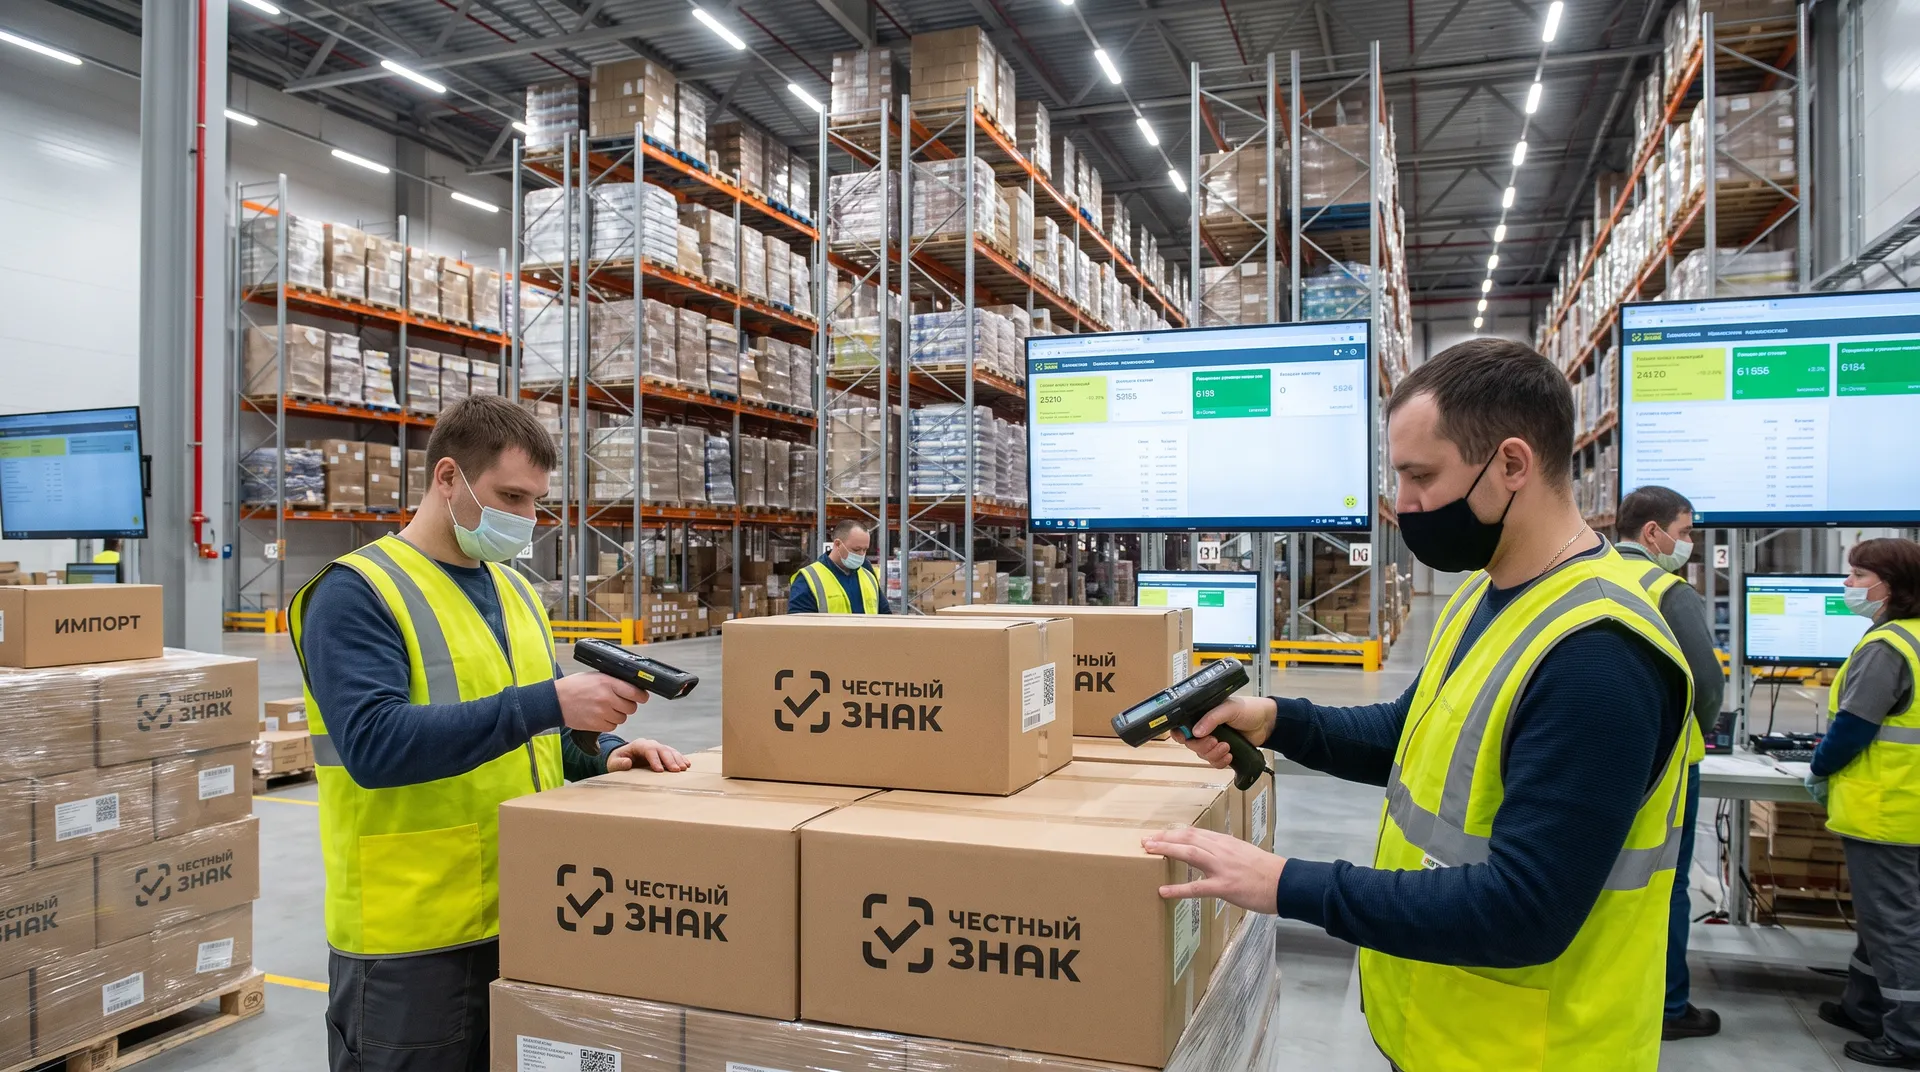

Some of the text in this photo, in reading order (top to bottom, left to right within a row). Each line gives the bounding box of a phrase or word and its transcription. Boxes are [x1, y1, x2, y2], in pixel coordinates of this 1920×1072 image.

[1040, 396, 1062, 404] 25210
[1716, 549, 1727, 565] 3
[55, 614, 141, 635] ИМПОРТ
[1072, 651, 1116, 667] НЫЙ
[178, 686, 233, 704] ЧЕСТНЫЙ
[842, 679, 944, 699] ЧЕСТНЫЙ
[178, 700, 233, 722] ЗНАК
[841, 701, 944, 733] ЗНАК
[176, 848, 234, 873] ЧЕСТНЫЙ
[176, 863, 233, 893] ЗНАК
[625, 878, 728, 907] ЧЕСТНЫЙ
[624, 902, 729, 943] ЗНАК
[948, 909, 1081, 941] ЧЕСТНЫЙ
[947, 936, 1081, 983] ЗНАК
